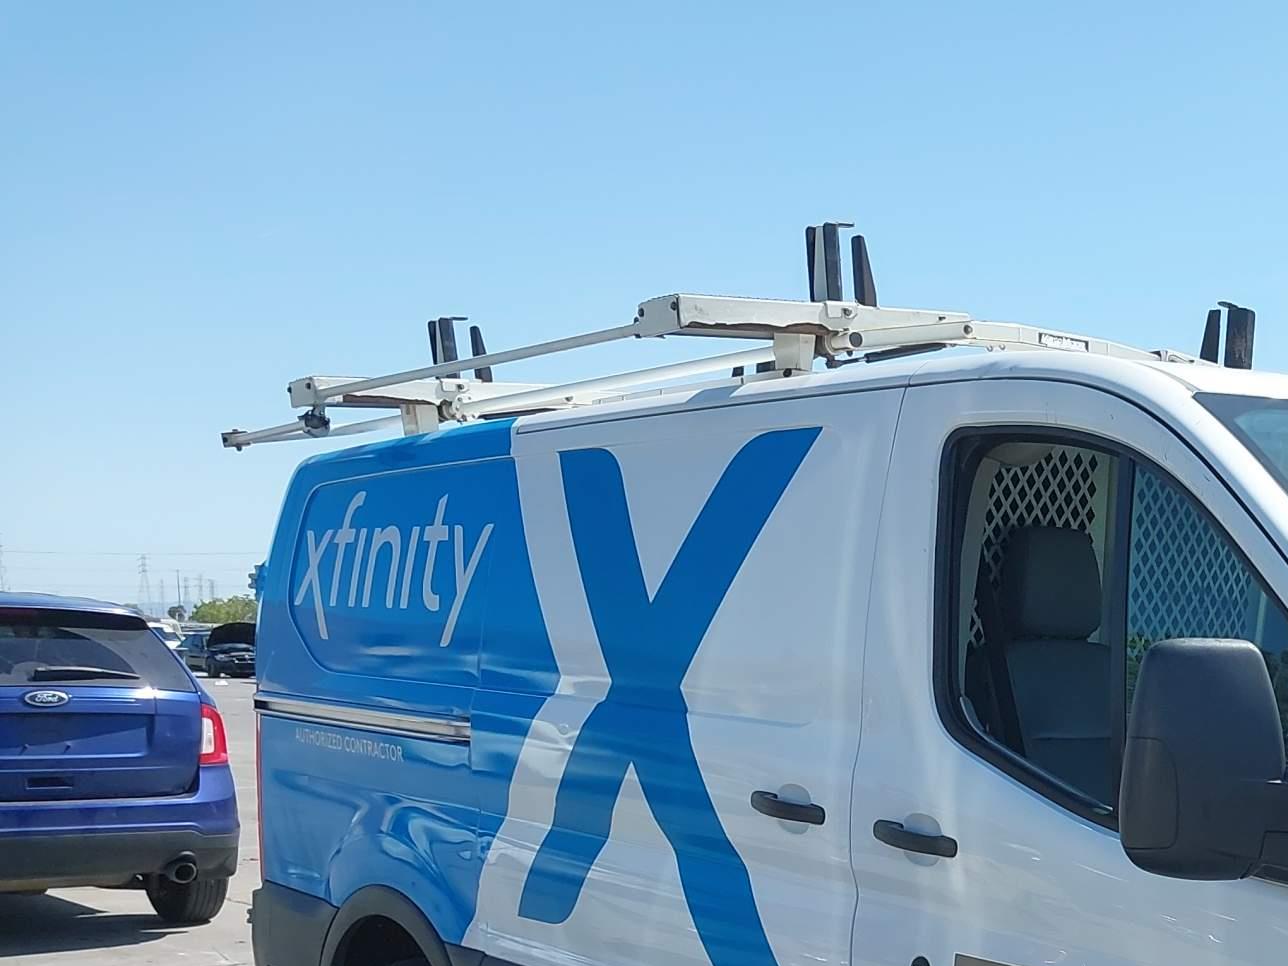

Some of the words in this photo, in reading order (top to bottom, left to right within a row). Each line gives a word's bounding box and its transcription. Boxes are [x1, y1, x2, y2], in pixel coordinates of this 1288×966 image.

[294, 491, 494, 647] xfinity
[295, 727, 342, 749] AUTHORIZED
[343, 736, 404, 762] CONTRACTOR
